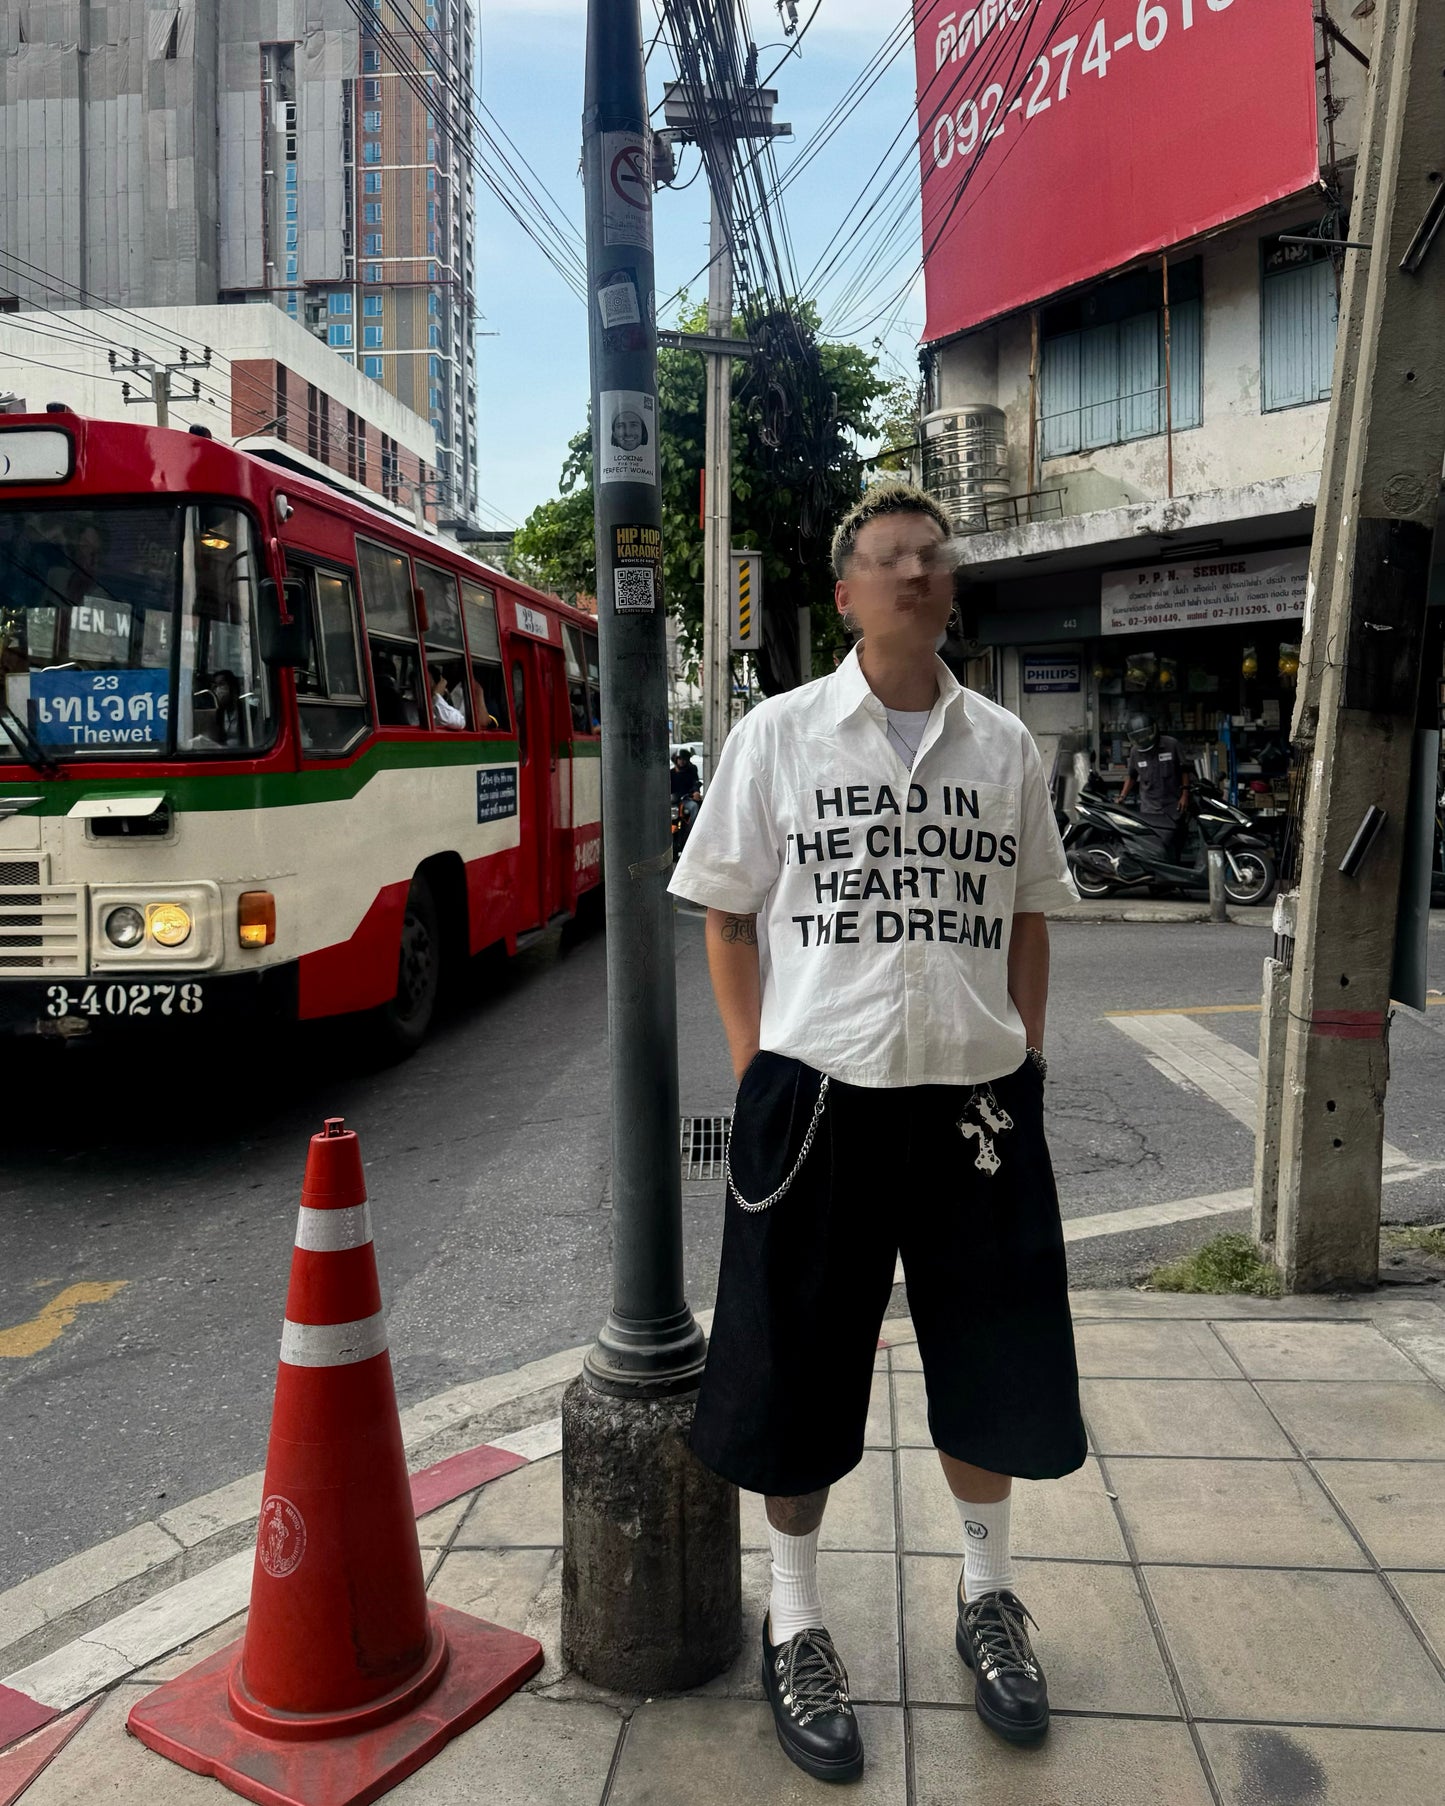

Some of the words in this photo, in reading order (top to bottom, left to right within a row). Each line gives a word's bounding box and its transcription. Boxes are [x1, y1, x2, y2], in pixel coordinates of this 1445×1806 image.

[933, 0, 1236, 169] 092-274-61
[603, 466, 628, 474] PERFECT
[630, 466, 654, 476] WOMAN
[616, 527, 638, 544] HIP
[640, 528, 660, 545] HOP
[617, 544, 660, 558] KARAOKE
[1193, 561, 1247, 578] SERVICE
[1276, 601, 1305, 612] 01-62
[92, 675, 119, 690] 23
[1027, 669, 1077, 679] PHILIPS
[69, 725, 152, 743] Thewet
[815, 784, 928, 819] HEAD
[943, 786, 980, 819] IN
[866, 824, 1017, 867] CLOUDS
[814, 866, 945, 904] HEART
[954, 871, 987, 905] IN
[792, 911, 860, 947] THE
[876, 908, 1003, 950] DREAM
[47, 983, 203, 1016] 3-40278
